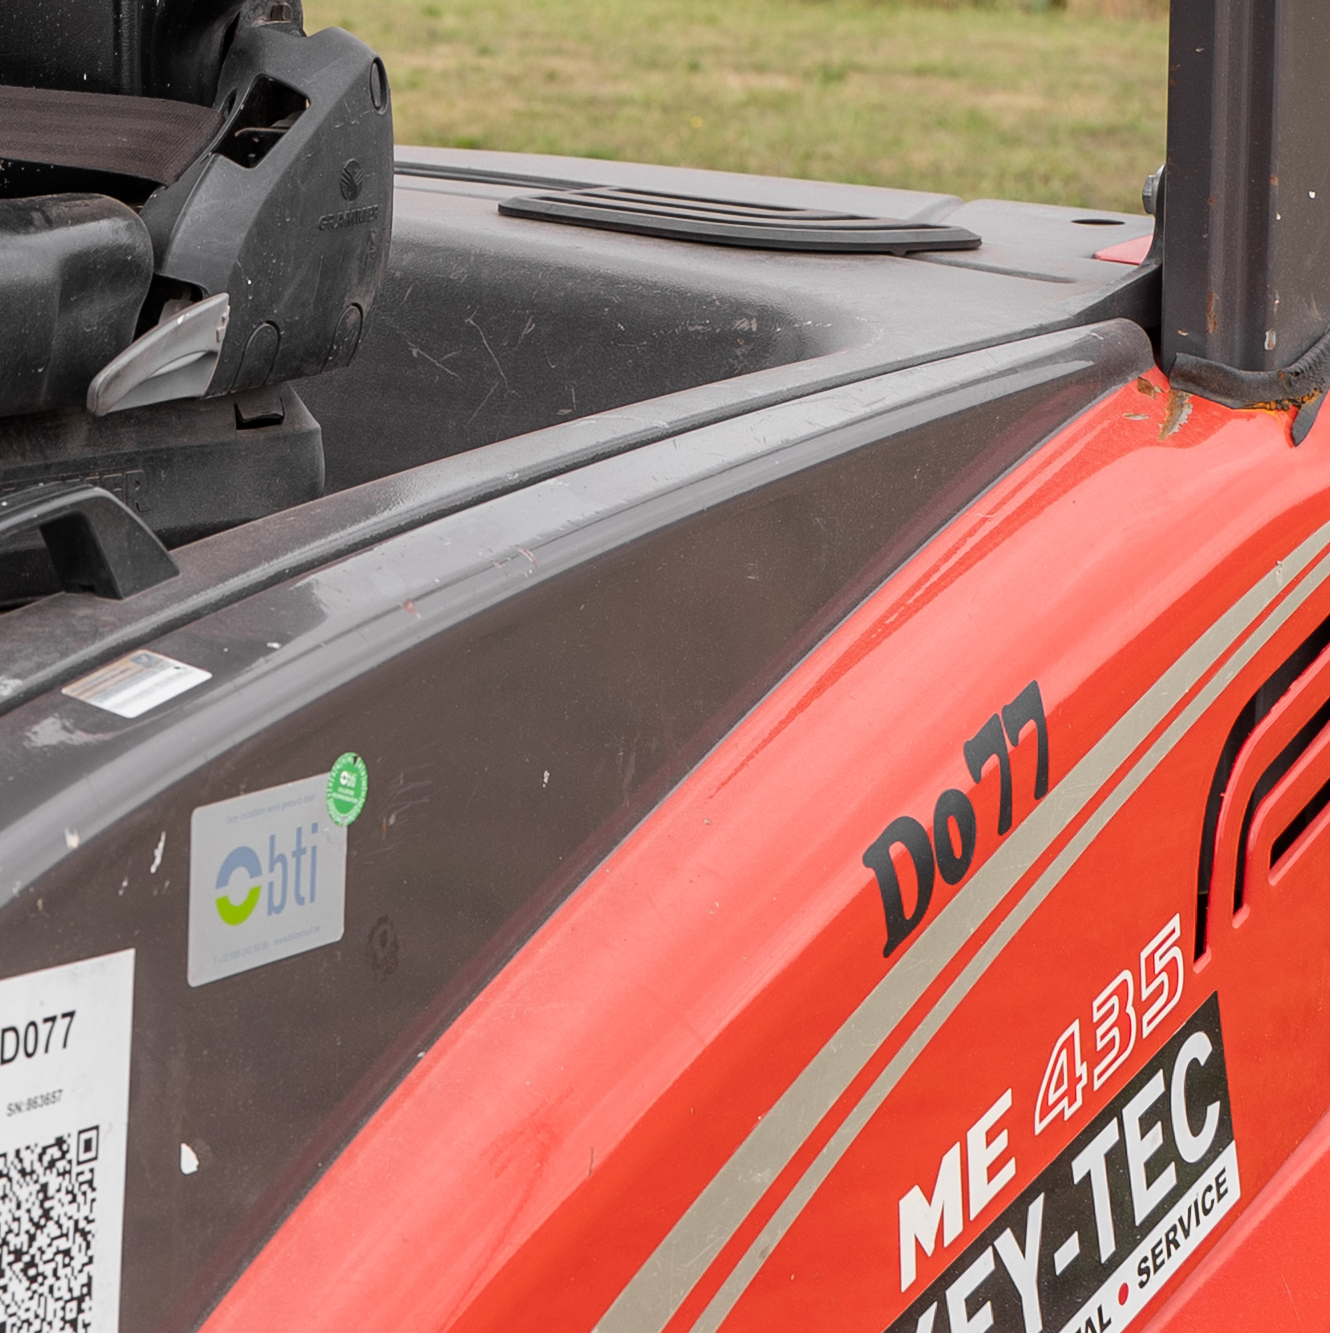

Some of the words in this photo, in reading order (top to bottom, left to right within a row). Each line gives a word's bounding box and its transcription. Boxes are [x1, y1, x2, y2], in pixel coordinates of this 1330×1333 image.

[318, 204, 379, 231] GRAMMER
[0, 1009, 77, 1066] D077
[898, 1087, 1017, 1293] ME
[1034, 912, 1184, 1136] 435
[1075, 1303, 1112, 1333] AL
[1136, 1168, 1229, 1289] SERVICE
